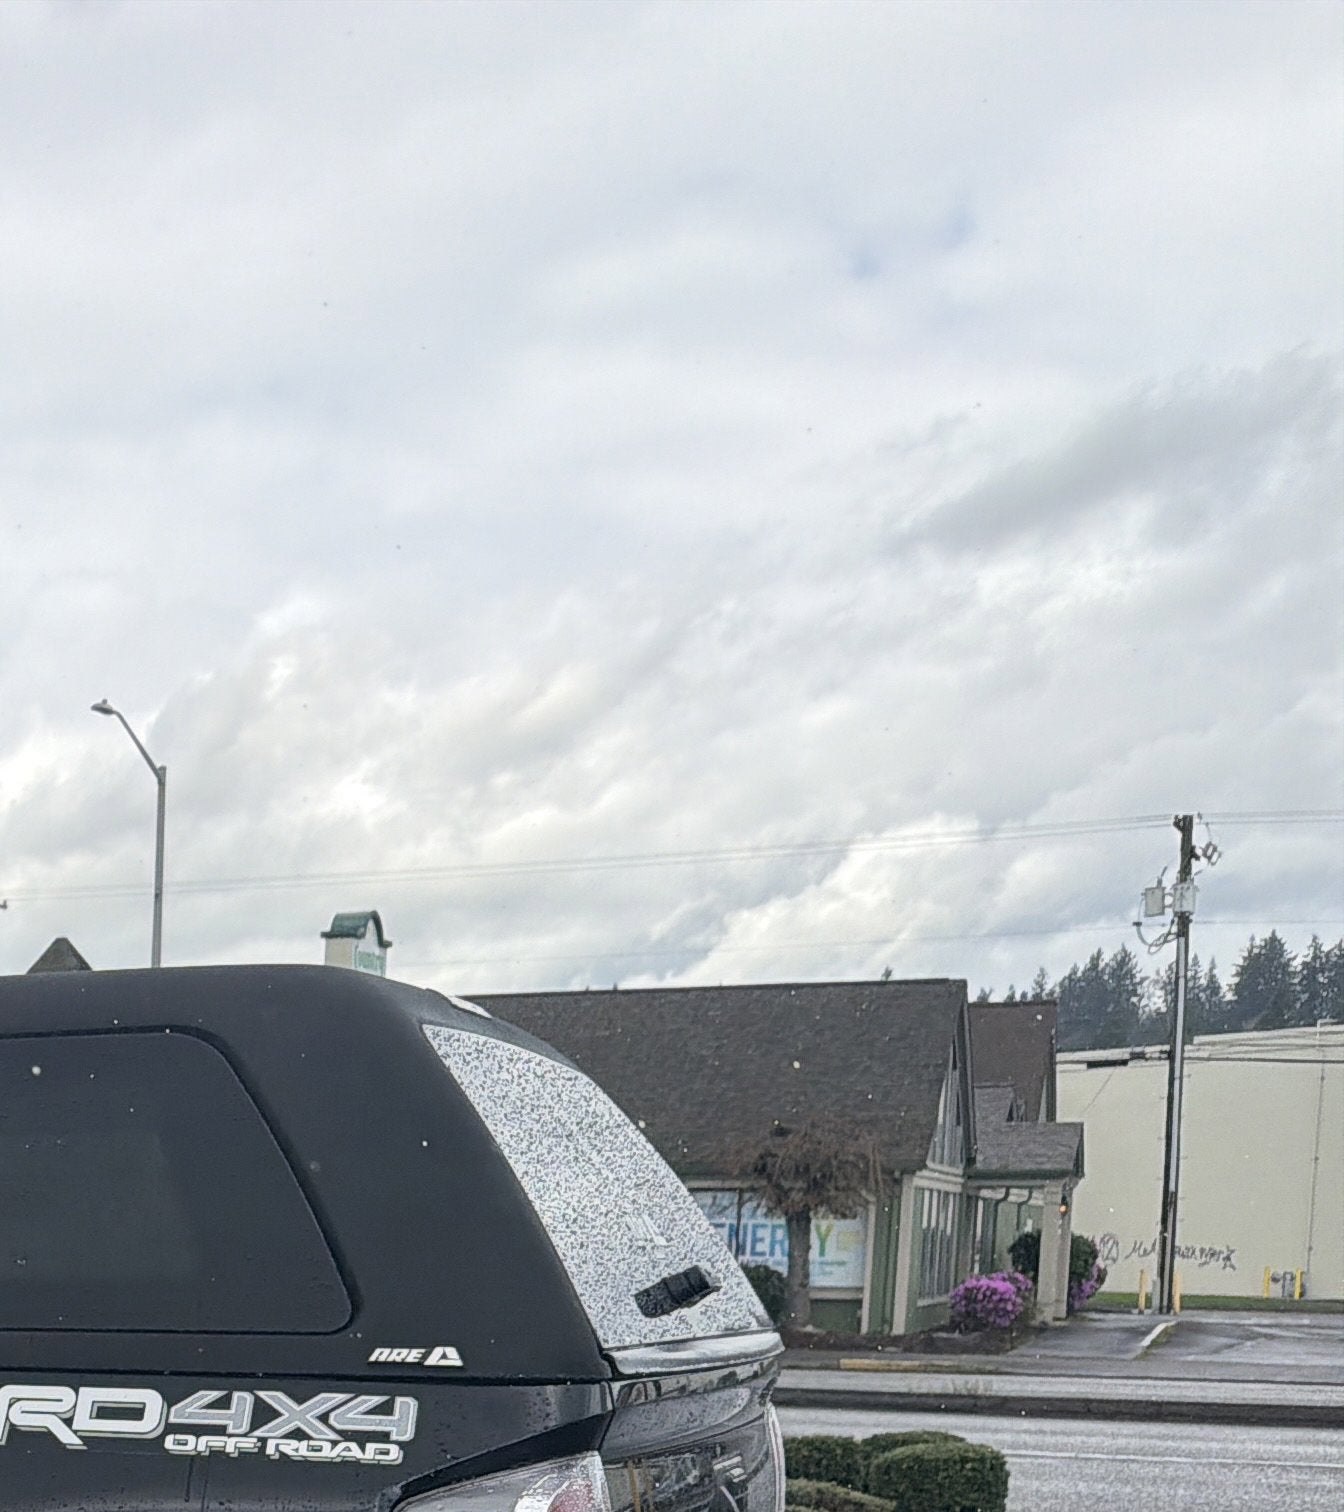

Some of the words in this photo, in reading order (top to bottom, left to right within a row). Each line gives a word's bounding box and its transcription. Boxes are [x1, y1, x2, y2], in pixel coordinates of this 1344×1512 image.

[711, 1222, 835, 1258] NERY
[164, 1433, 261, 1459] OFF
[265, 1438, 404, 1466] ROAD
